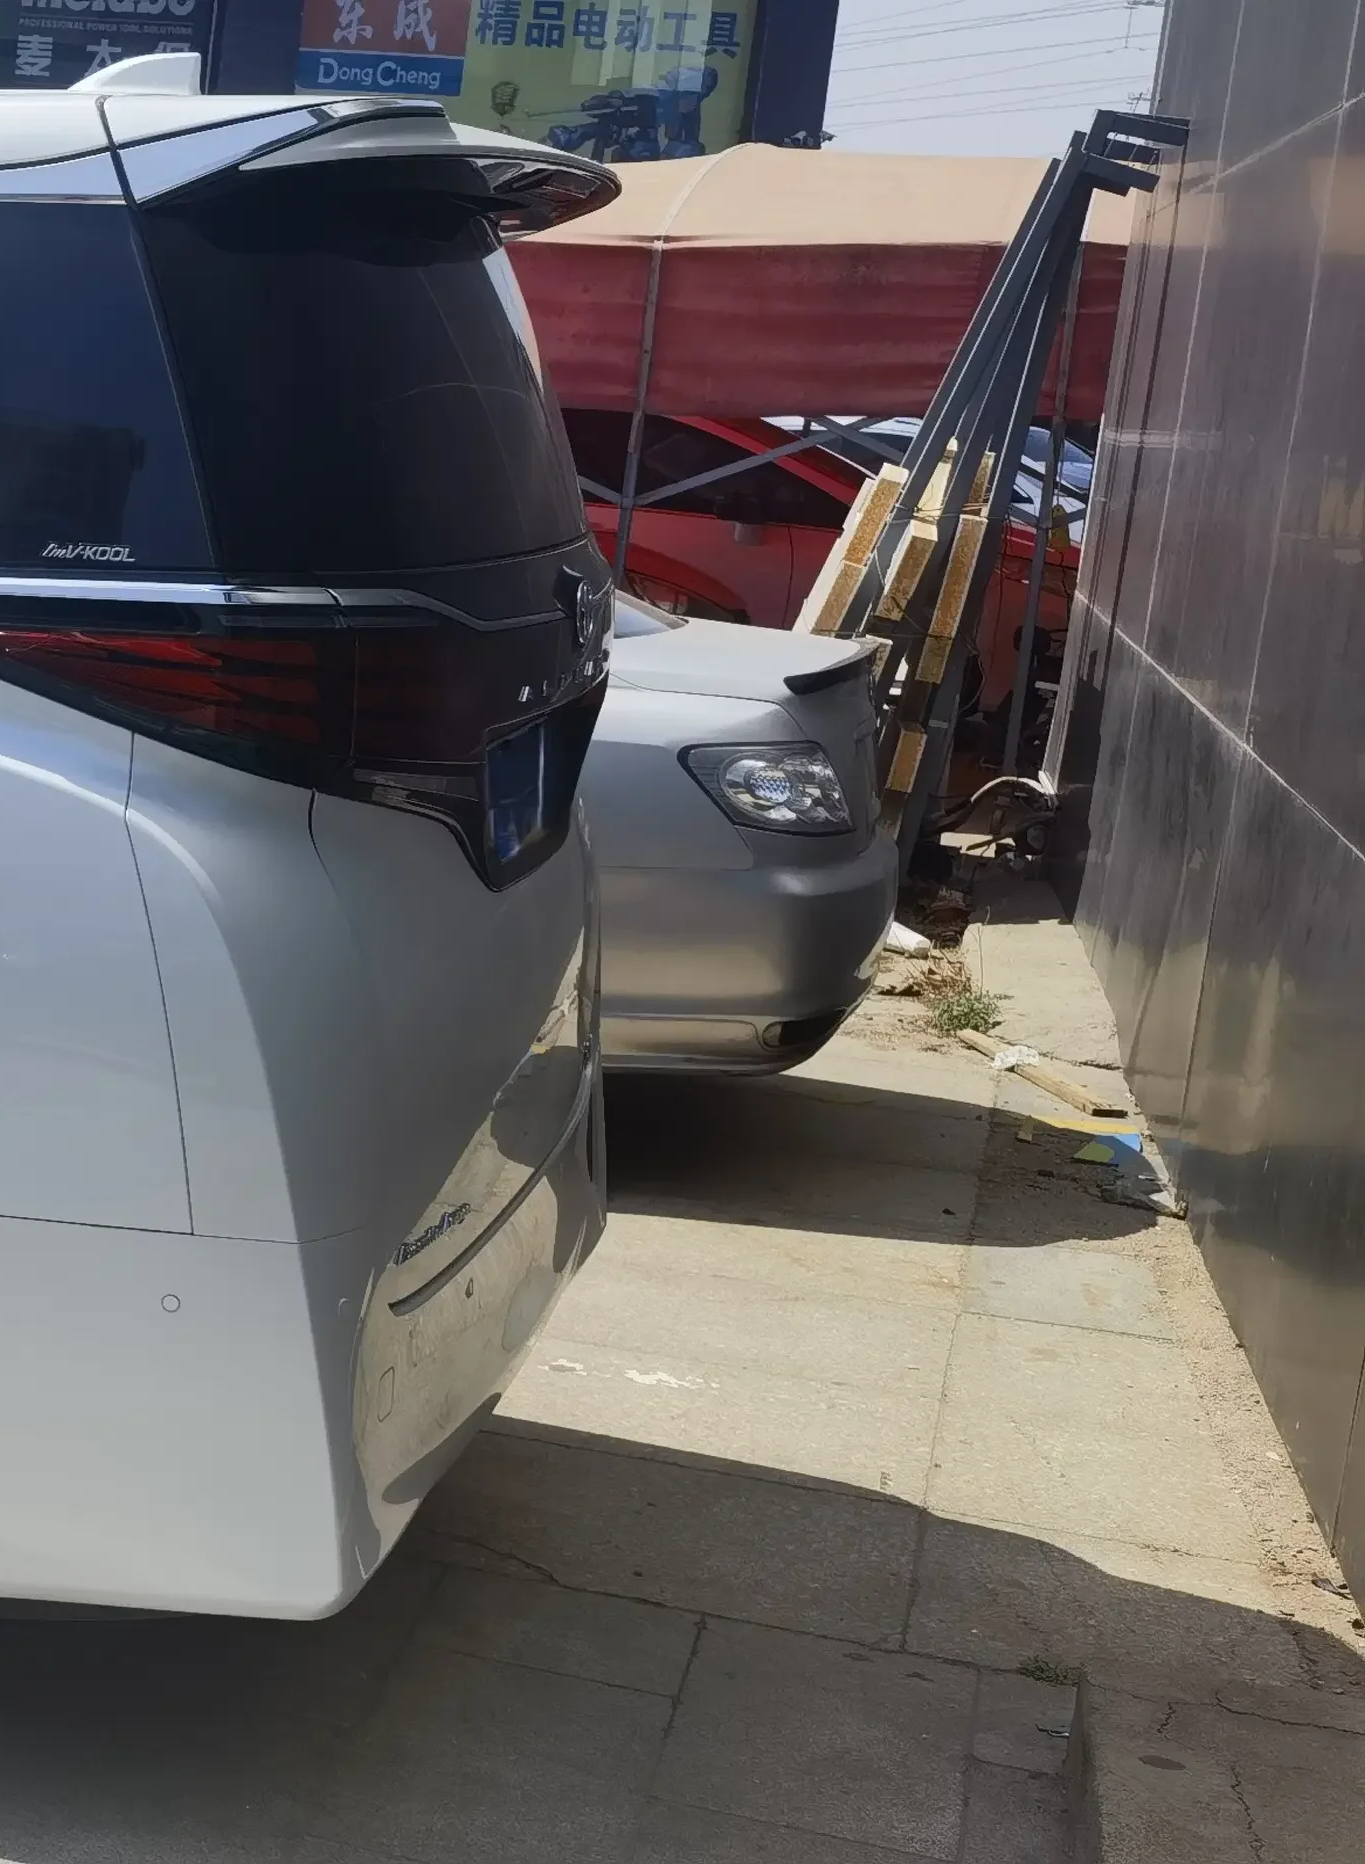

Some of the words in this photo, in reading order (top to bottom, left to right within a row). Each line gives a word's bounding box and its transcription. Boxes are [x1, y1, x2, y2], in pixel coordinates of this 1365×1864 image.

[475, 0, 741, 59] 精品电动工具
